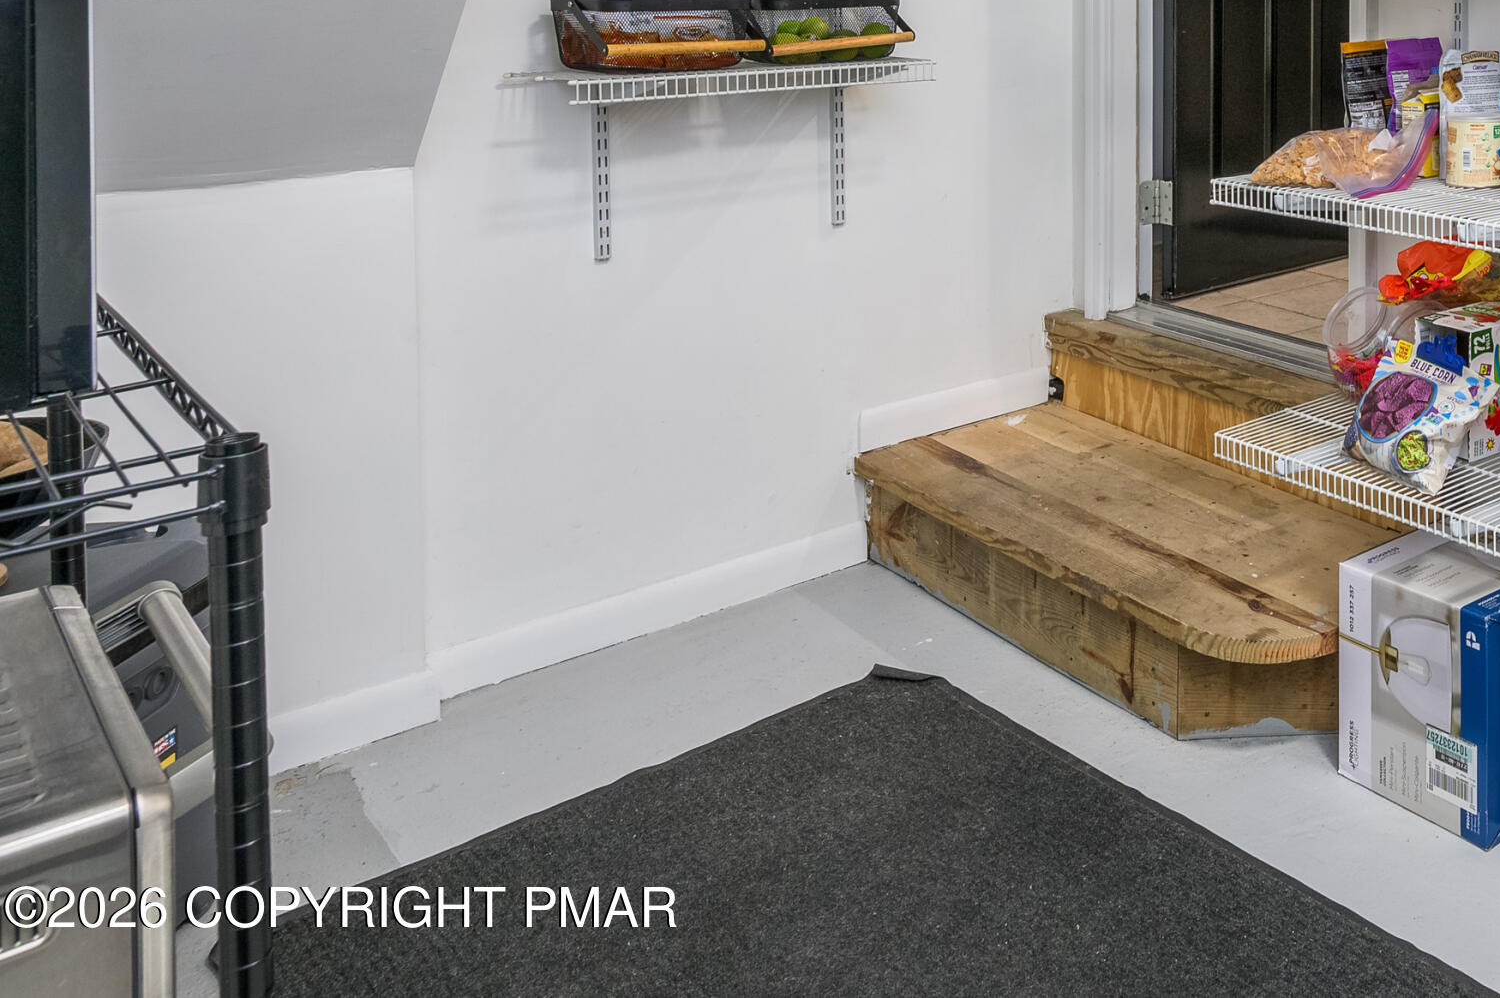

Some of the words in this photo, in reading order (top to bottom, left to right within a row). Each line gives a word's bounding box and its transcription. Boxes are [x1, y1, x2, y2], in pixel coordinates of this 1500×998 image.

[1473, 335, 1487, 355] 72
[1410, 358, 1433, 375] BLUE
[1434, 366, 1457, 384] CORN
[1426, 729, 1469, 757] 1012337257
